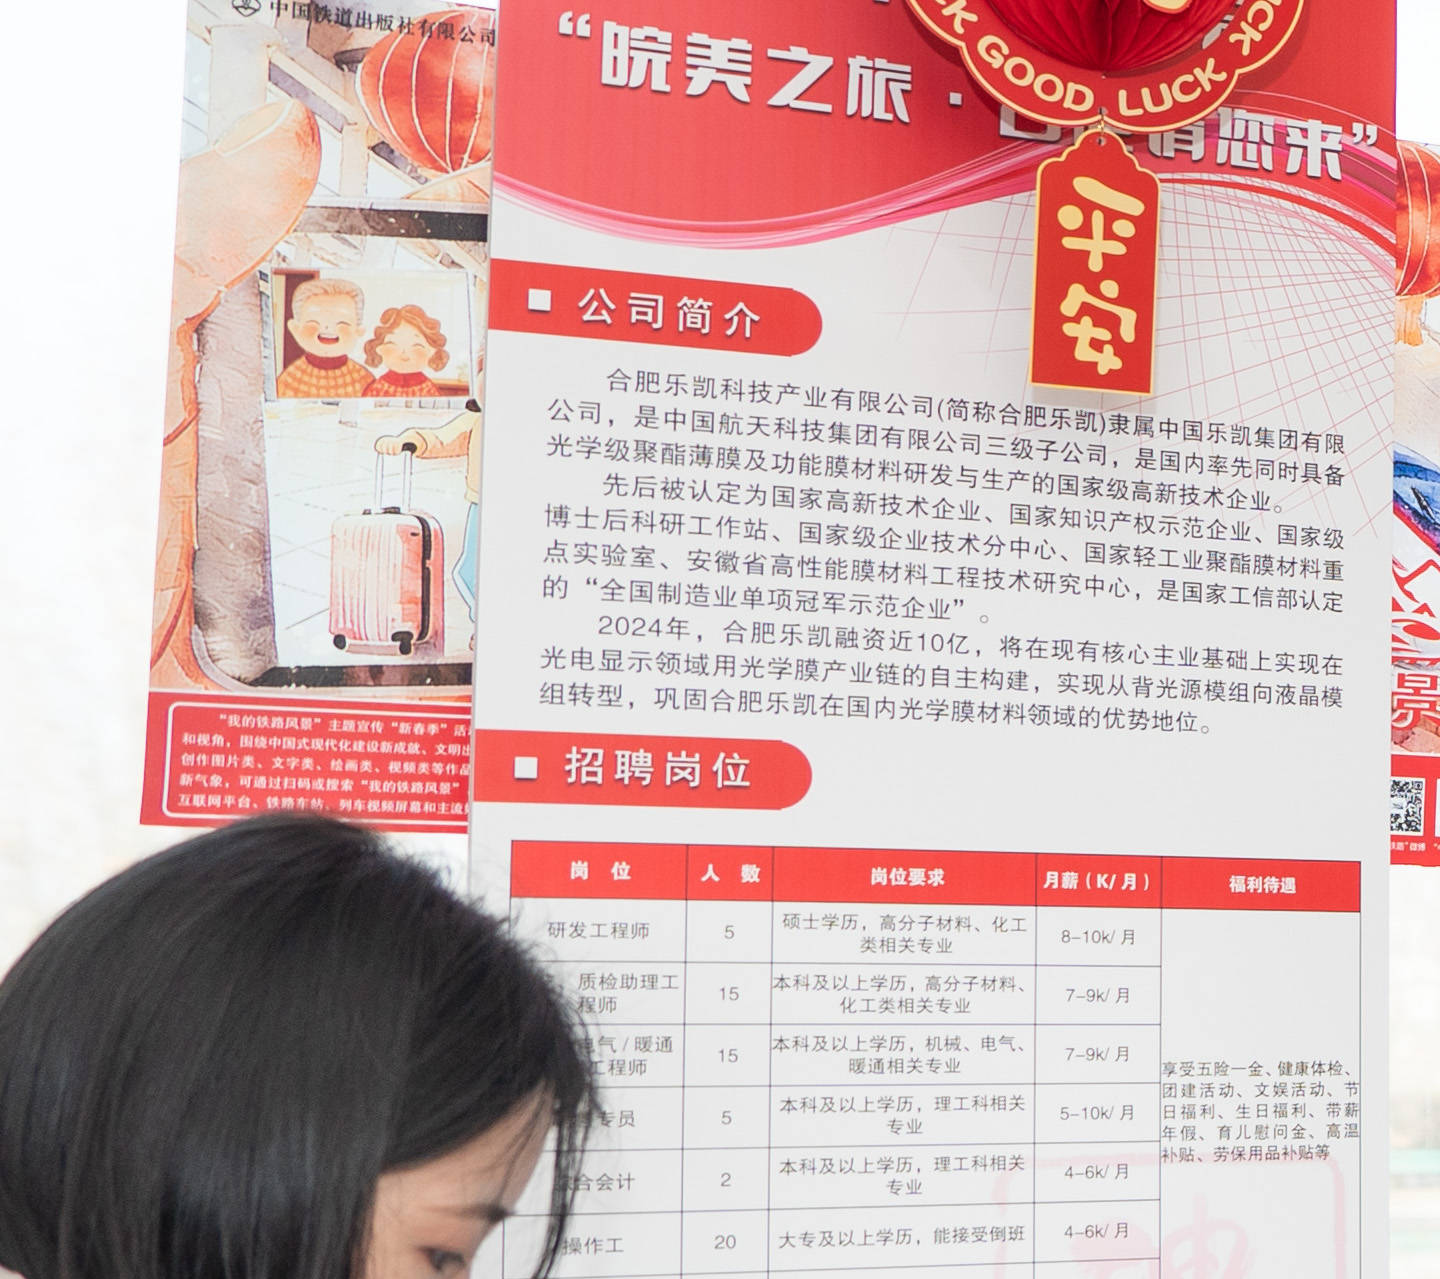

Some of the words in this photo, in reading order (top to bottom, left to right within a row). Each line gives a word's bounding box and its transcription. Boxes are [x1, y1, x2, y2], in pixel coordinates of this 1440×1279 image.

[976, 33, 1096, 113] GOOD
[1117, 57, 1228, 117] LUCK
[1056, 175, 1147, 376] 平安
[578, 286, 761, 338] 公司简介
[564, 745, 753, 793] 招聘岗位
[870, 866, 946, 887] 岗位要求
[1229, 874, 1297, 896] 福利待遇
[547, 921, 650, 940] 研发工程师
[724, 925, 735, 940] 5
[782, 913, 1028, 935] 硕士学历，高分子材料、化工
[859, 935, 954, 956] 类相关专业
[719, 986, 739, 1001] 15
[772, 973, 1027, 995] 本科及以上学历，高分子材料、
[838, 996, 971, 1017] 化工类相关专业
[718, 1048, 738, 1064] 15
[771, 1034, 1027, 1056] 本科及以上学历，机械、电气、
[848, 1056, 961, 1076] 暖通相关专业
[1162, 1060, 1351, 1078] 享受五险一金、健康体检、
[1162, 1081, 1360, 1099] 团建活动、文娱活动、节
[721, 1111, 731, 1125] 5
[779, 1094, 1027, 1115] 本科及以上学历，理工科相关
[1163, 1102, 1360, 1120] 日福利、生日福利、带薪
[887, 1117, 923, 1136] 专业
[1162, 1123, 1360, 1141] 年假、育儿慰问金、高温
[1162, 1144, 1330, 1163] 补贴、劳保用品补贴等
[721, 1173, 731, 1187] 2
[778, 1155, 1027, 1176] 本科及以上学历，理工科相关
[887, 1177, 923, 1197] 专业
[561, 1237, 624, 1255] 操作工
[714, 1234, 737, 1250] 20
[777, 1225, 1026, 1250] 大专及以上学历，能接受倒班
